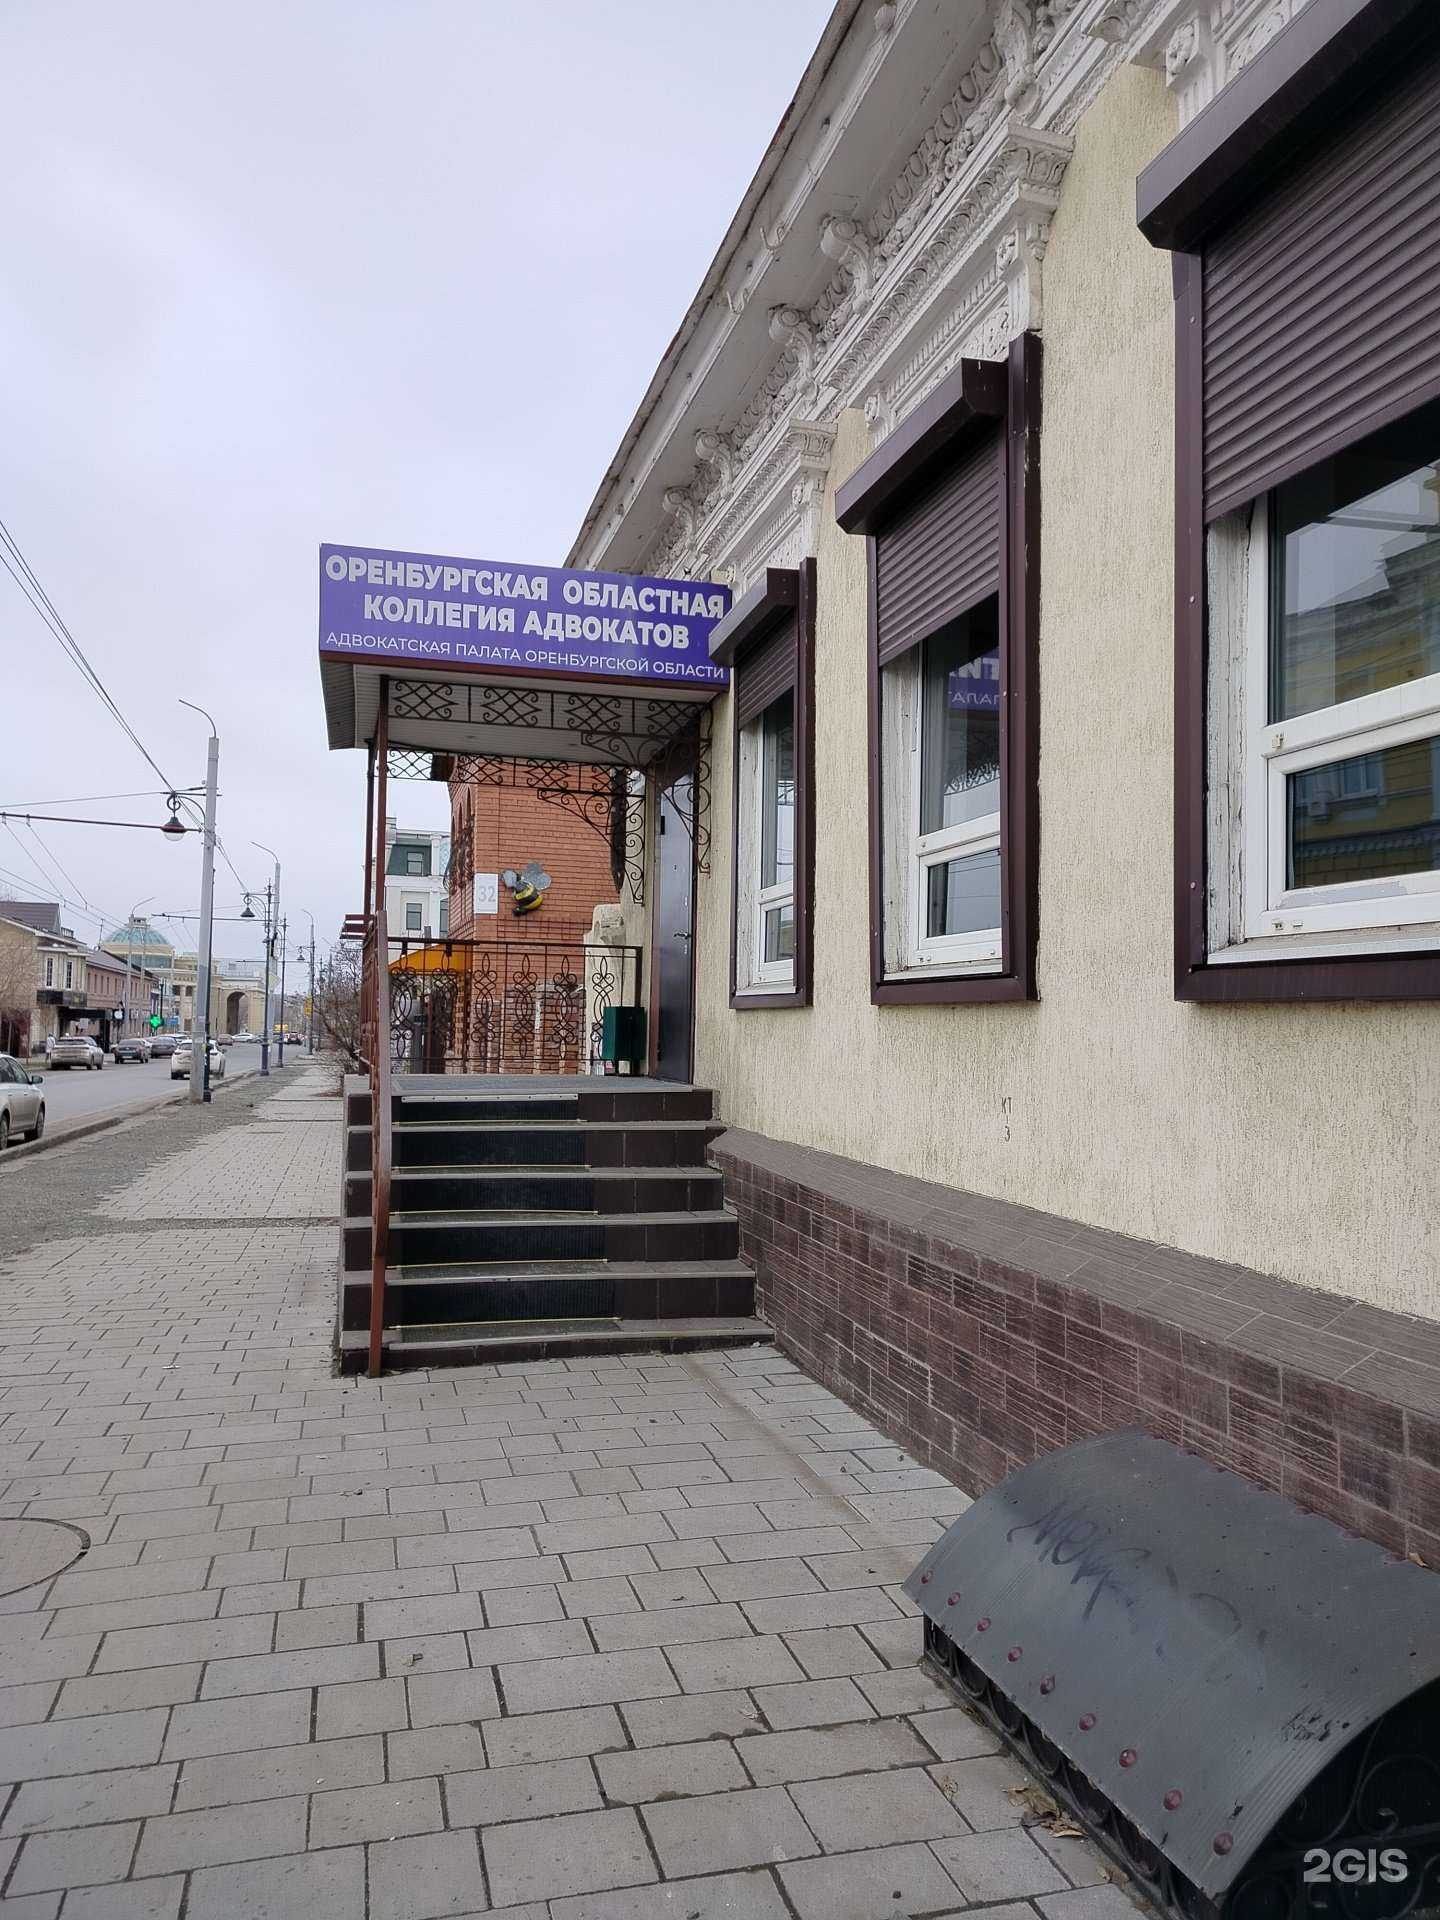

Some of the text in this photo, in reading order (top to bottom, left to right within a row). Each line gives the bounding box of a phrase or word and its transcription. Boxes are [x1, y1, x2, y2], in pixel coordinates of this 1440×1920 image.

[325, 554, 724, 619] ОРЕНБУРГСКАЯ ОБЛАСТНАЯ
[364, 594, 690, 649] КОЛЛЕГИЯ АДВОКАТОВ
[326, 632, 724, 678] АДВОКАТСКАЯ ПАЛАТА ОРЕНБУРГСКОЙ ОБЛАСТИ
[479, 885, 496, 903] 32
